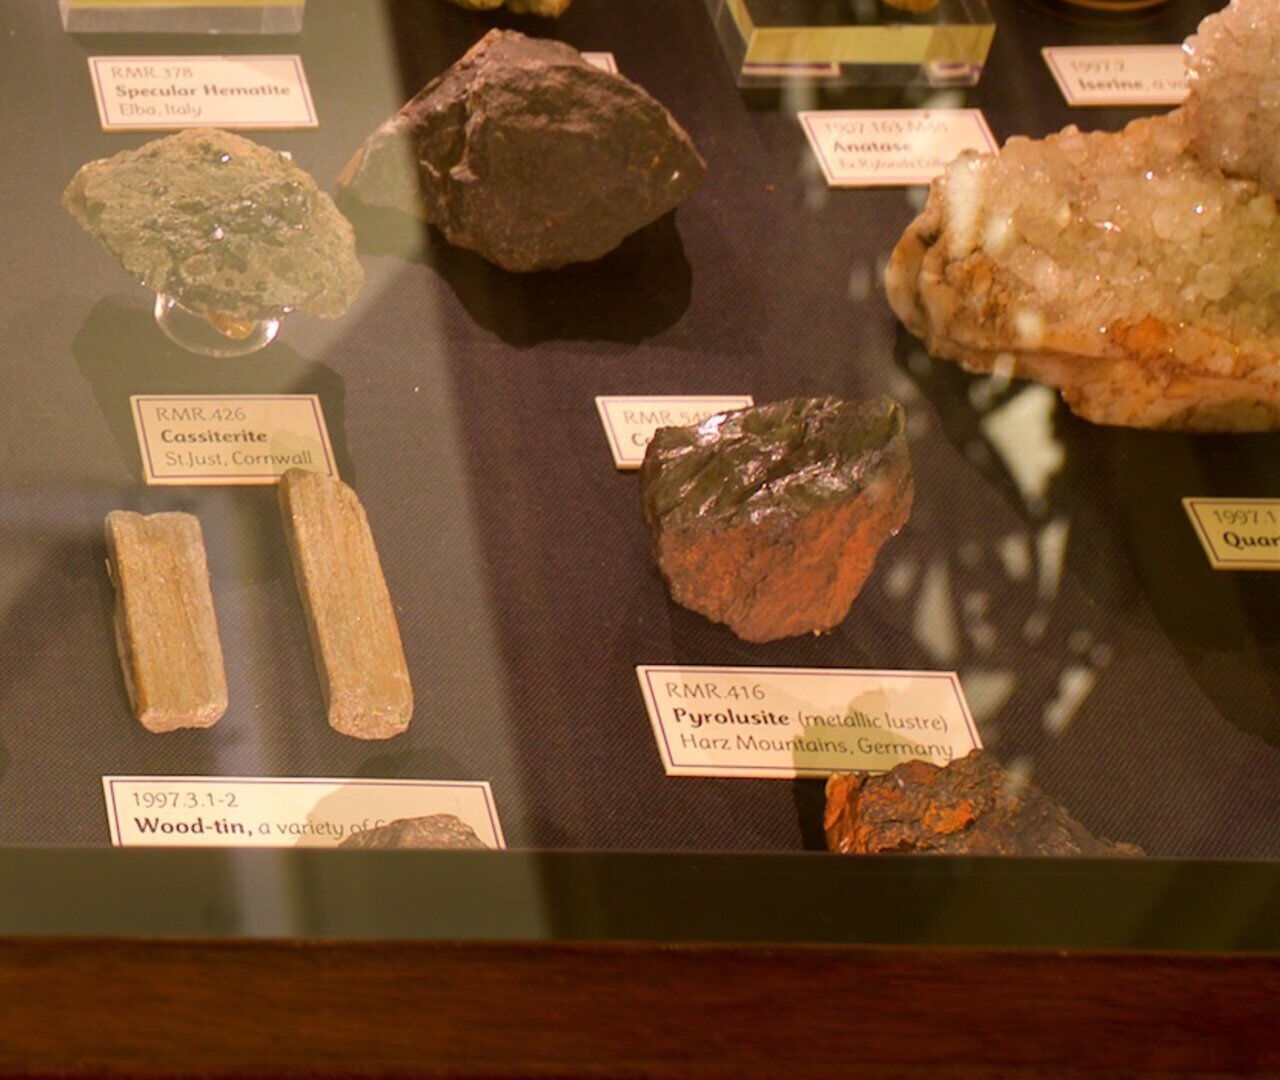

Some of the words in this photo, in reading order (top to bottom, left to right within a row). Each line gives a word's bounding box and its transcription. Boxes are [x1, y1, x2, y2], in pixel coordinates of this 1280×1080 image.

[116, 84, 198, 99] Specular
[204, 85, 291, 96] Hematite
[119, 103, 161, 117] Elba,
[165, 104, 202, 118] Italy
[834, 141, 914, 153] Anatase
[161, 429, 268, 443] Cassiterite
[232, 451, 313, 465] Cornwall
[665, 681, 766, 701] RMR.416
[673, 707, 791, 728] Pyrolusite
[797, 711, 882, 730] (metallic
[885, 711, 948, 732] lustre)
[679, 733, 732, 751] Harz
[736, 735, 855, 755] Mountains,
[858, 738, 954, 758] Germany
[132, 791, 239, 809] 1997.3.1-2
[134, 817, 254, 836] Wood-tin,
[278, 818, 344, 839] variety
